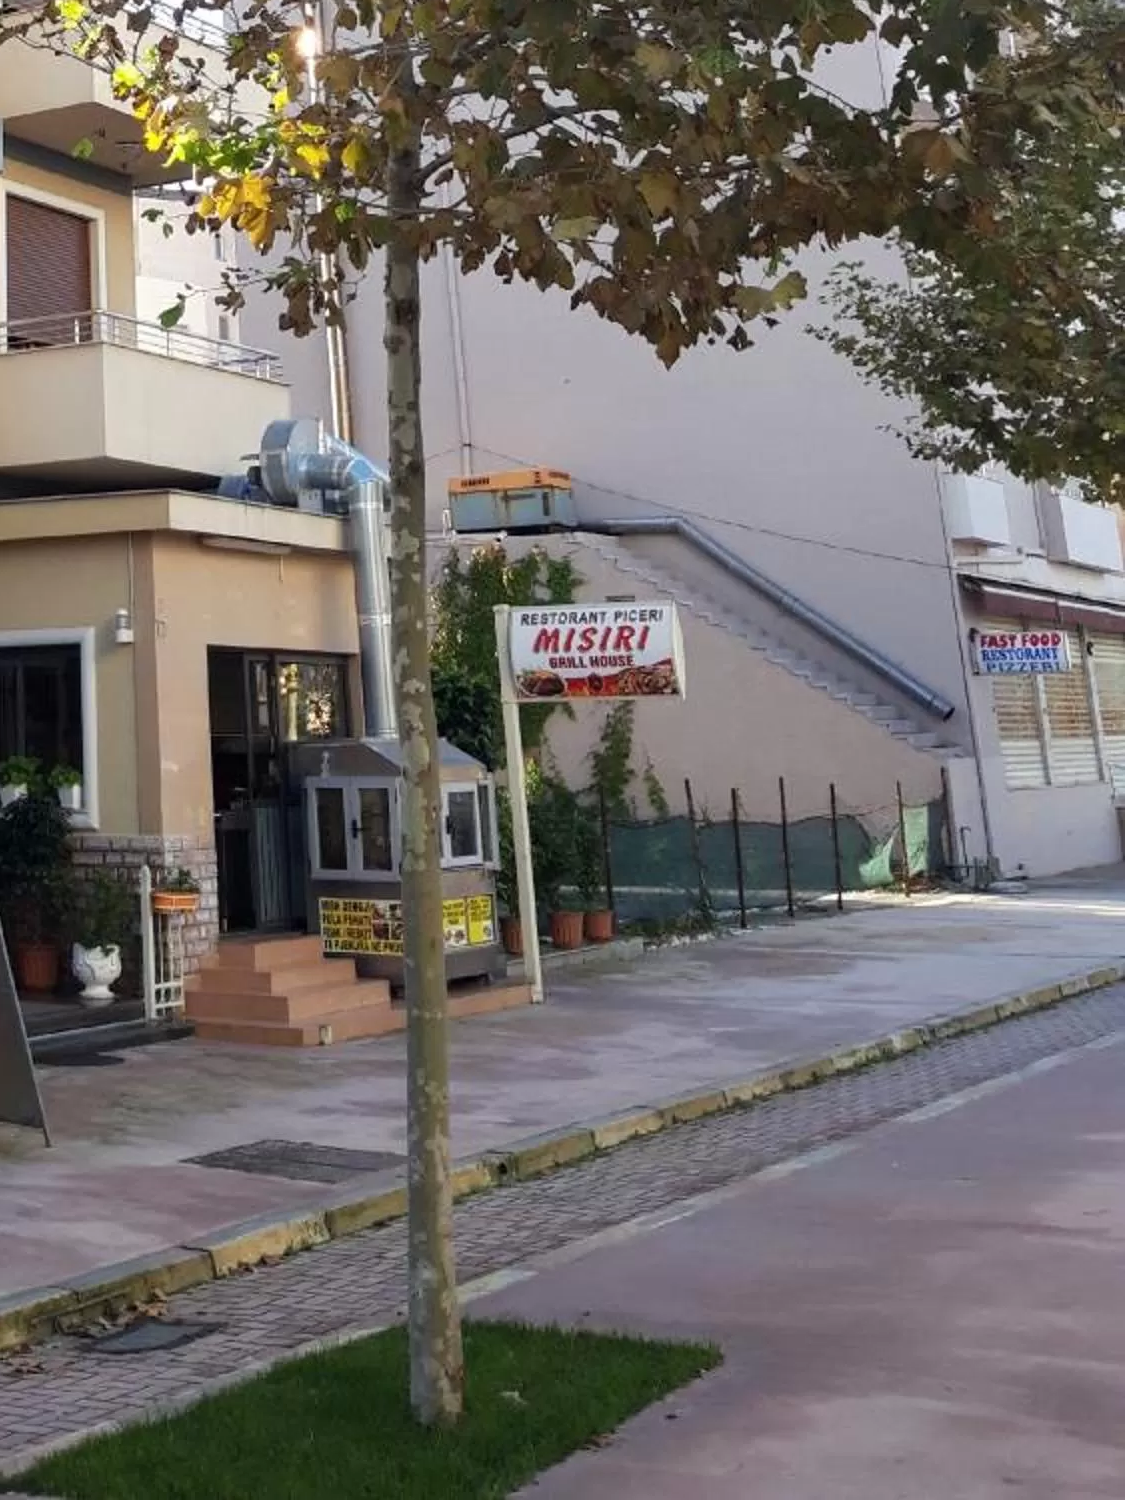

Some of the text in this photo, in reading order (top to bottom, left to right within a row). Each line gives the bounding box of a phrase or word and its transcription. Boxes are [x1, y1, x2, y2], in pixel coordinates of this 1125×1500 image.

[520, 609, 664, 626] RESTORANT PICERI
[532, 625, 651, 653] MISIRI
[980, 633, 1062, 648] FAST FOOD
[548, 654, 635, 669] GRILL HOUSE
[981, 647, 1058, 661] RESTORANT
